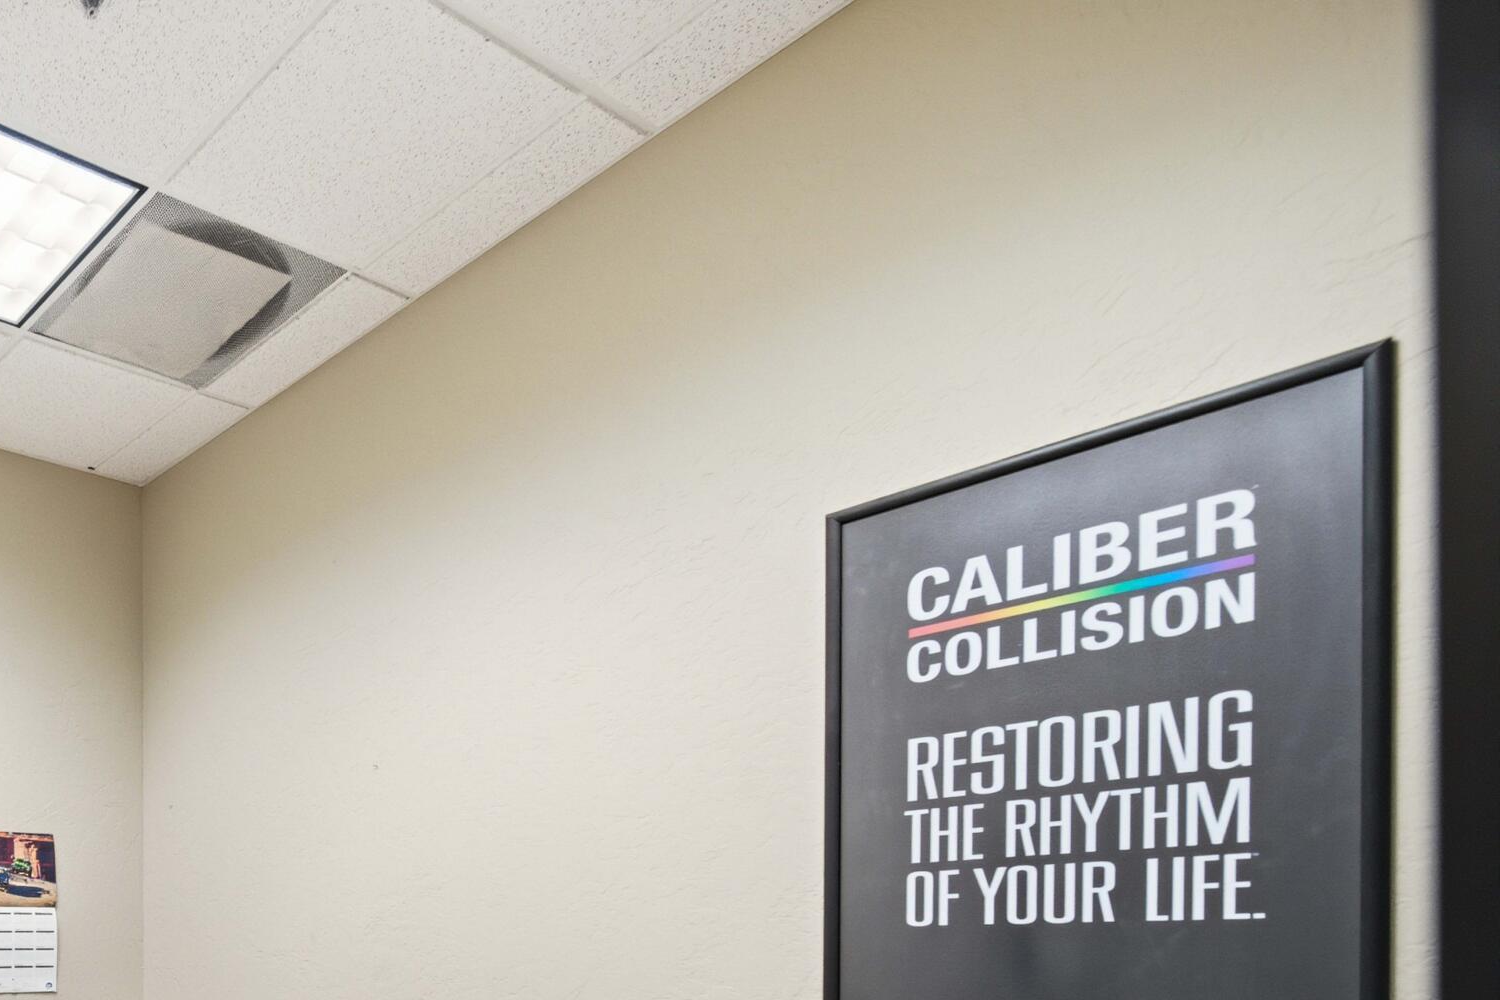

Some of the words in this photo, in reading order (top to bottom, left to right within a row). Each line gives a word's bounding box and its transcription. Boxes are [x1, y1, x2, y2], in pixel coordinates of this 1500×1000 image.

[907, 488, 1257, 622] CALIBER
[906, 572, 1256, 683] COLLISION
[906, 690, 1254, 801] RESTORING
[904, 803, 984, 864] THE
[1005, 776, 1251, 858] RHYTHM
[906, 869, 960, 927] OF
[973, 861, 1116, 925] YOUR
